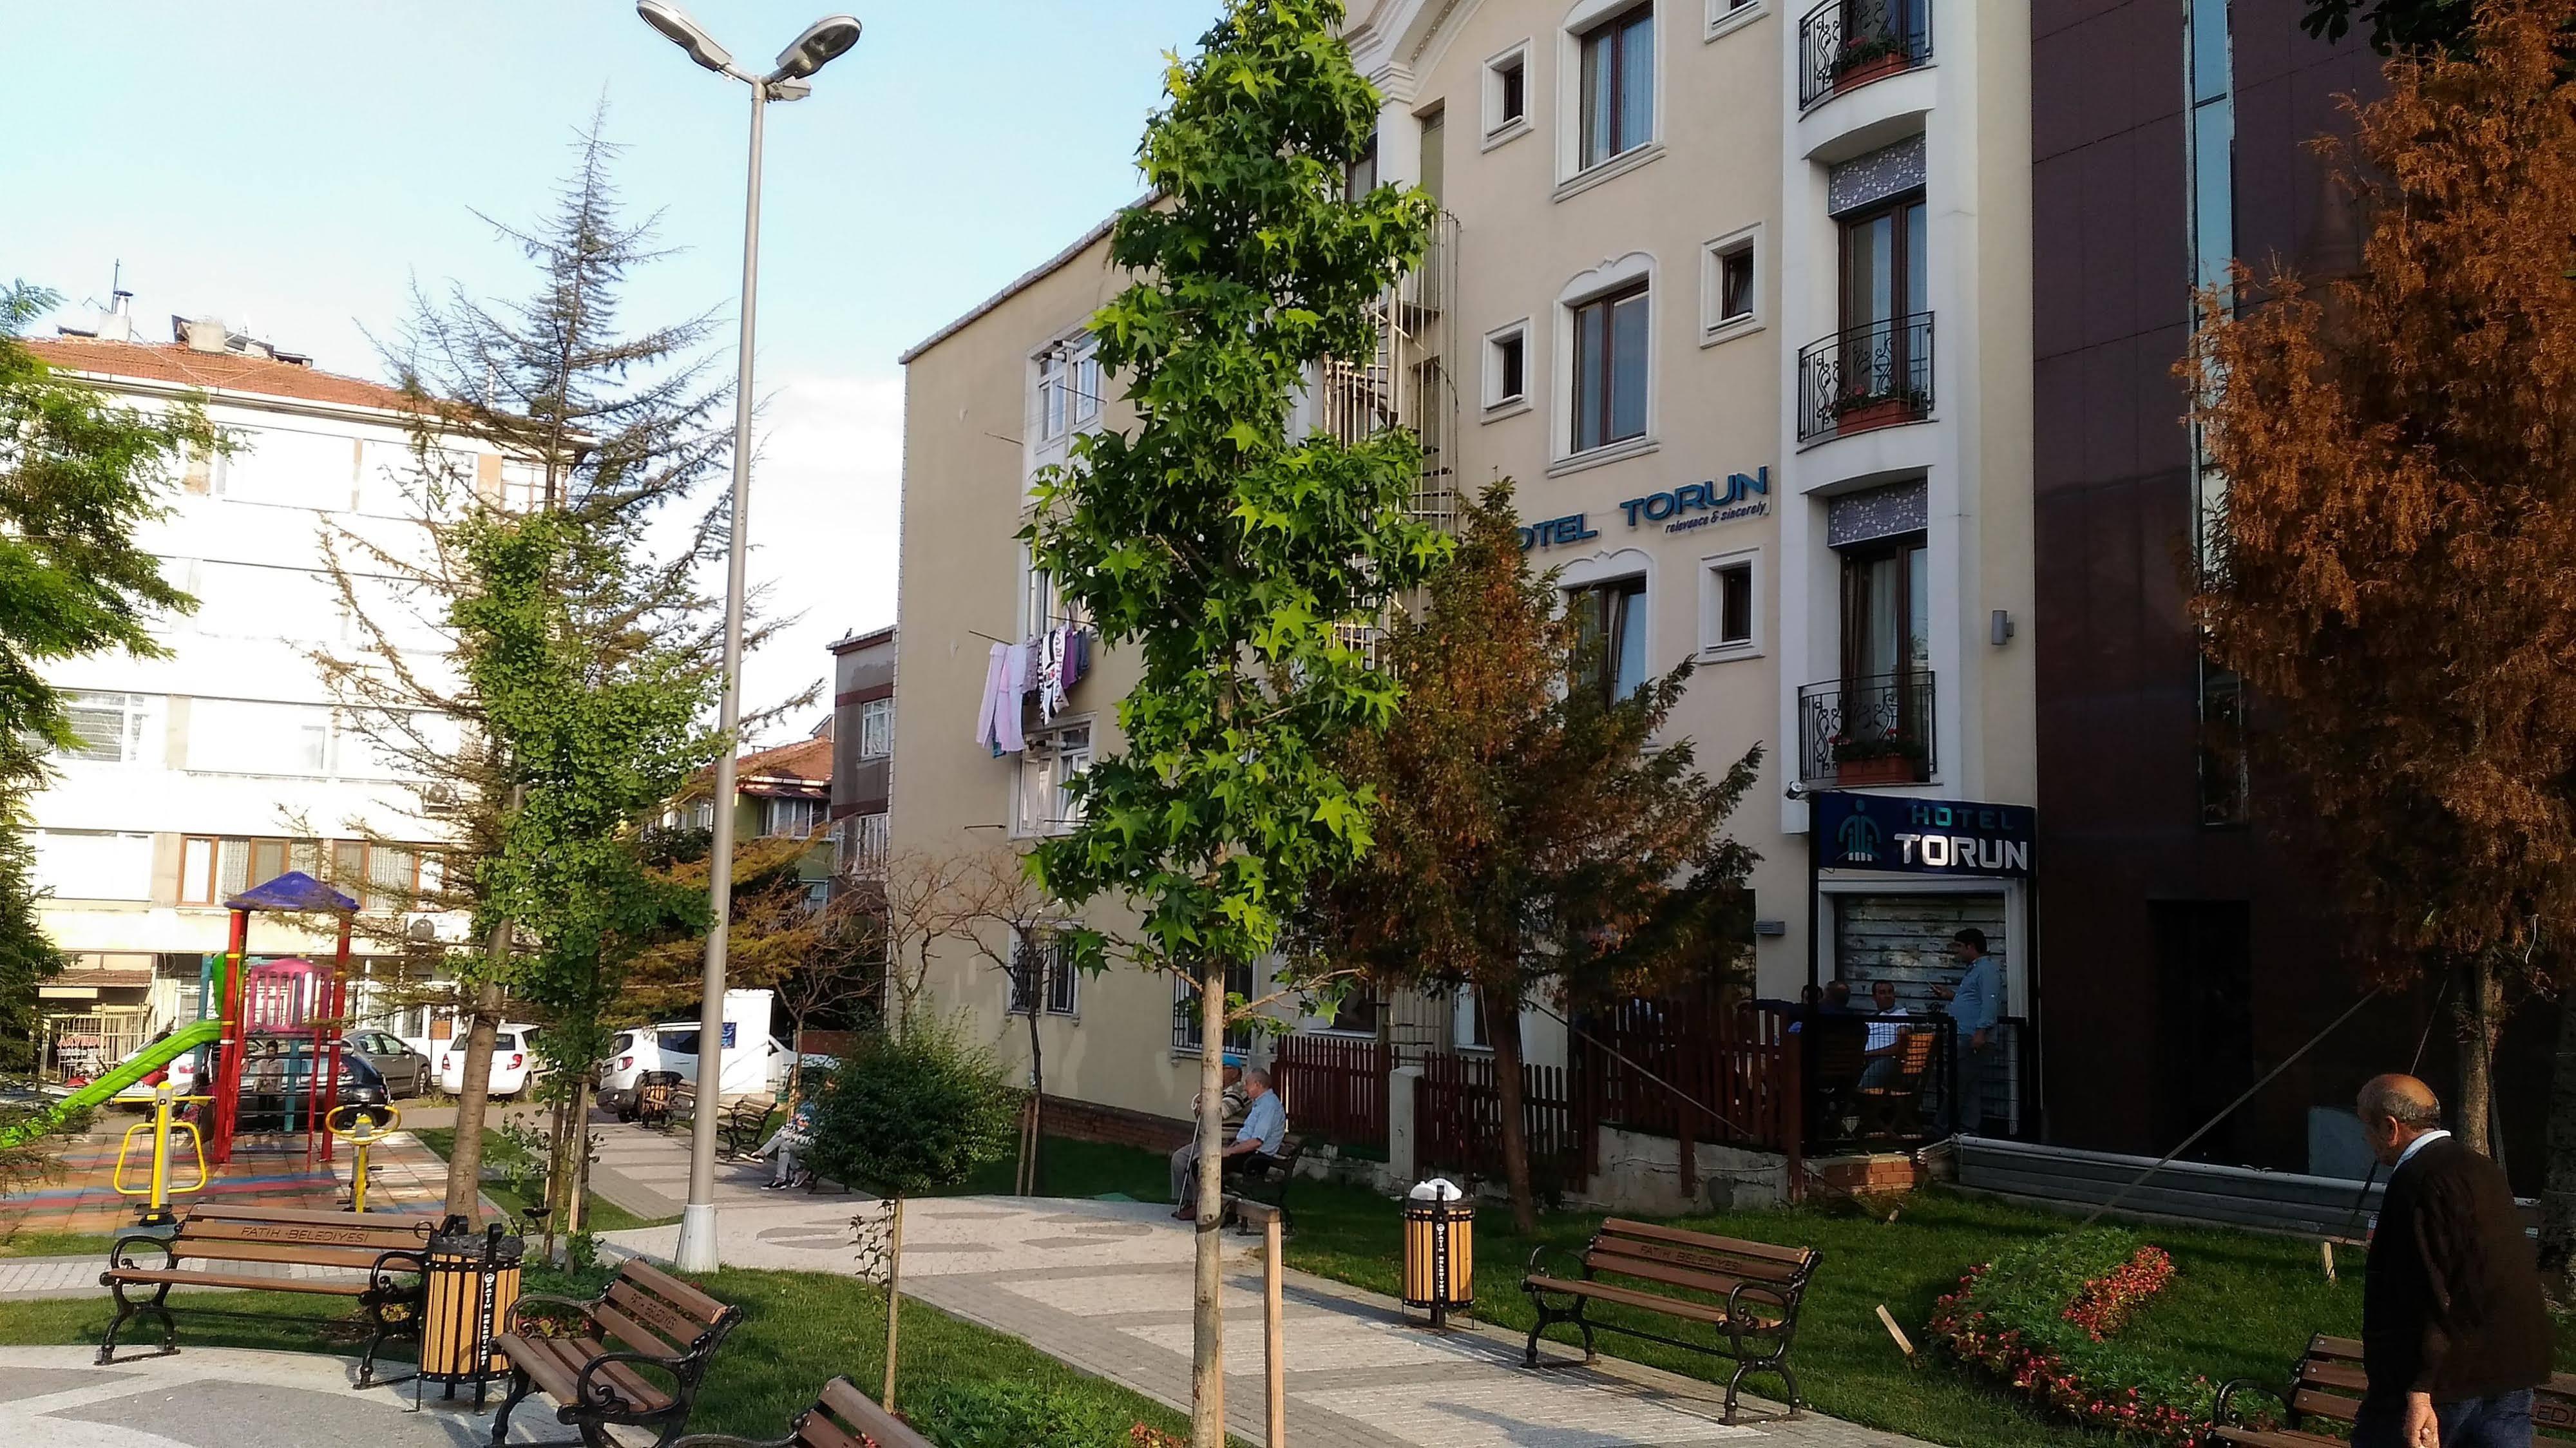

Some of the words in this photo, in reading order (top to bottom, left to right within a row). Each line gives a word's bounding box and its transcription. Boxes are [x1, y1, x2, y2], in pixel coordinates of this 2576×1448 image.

[1516, 513, 1598, 552] OTEL
[1619, 466, 1768, 527] TORUN
[1665, 515, 1708, 533] relevance
[1710, 511, 1719, 523] &
[1721, 500, 1766, 520] sincerely
[1911, 805, 2014, 830] HOTEL
[1894, 834, 2028, 870] TORUN
